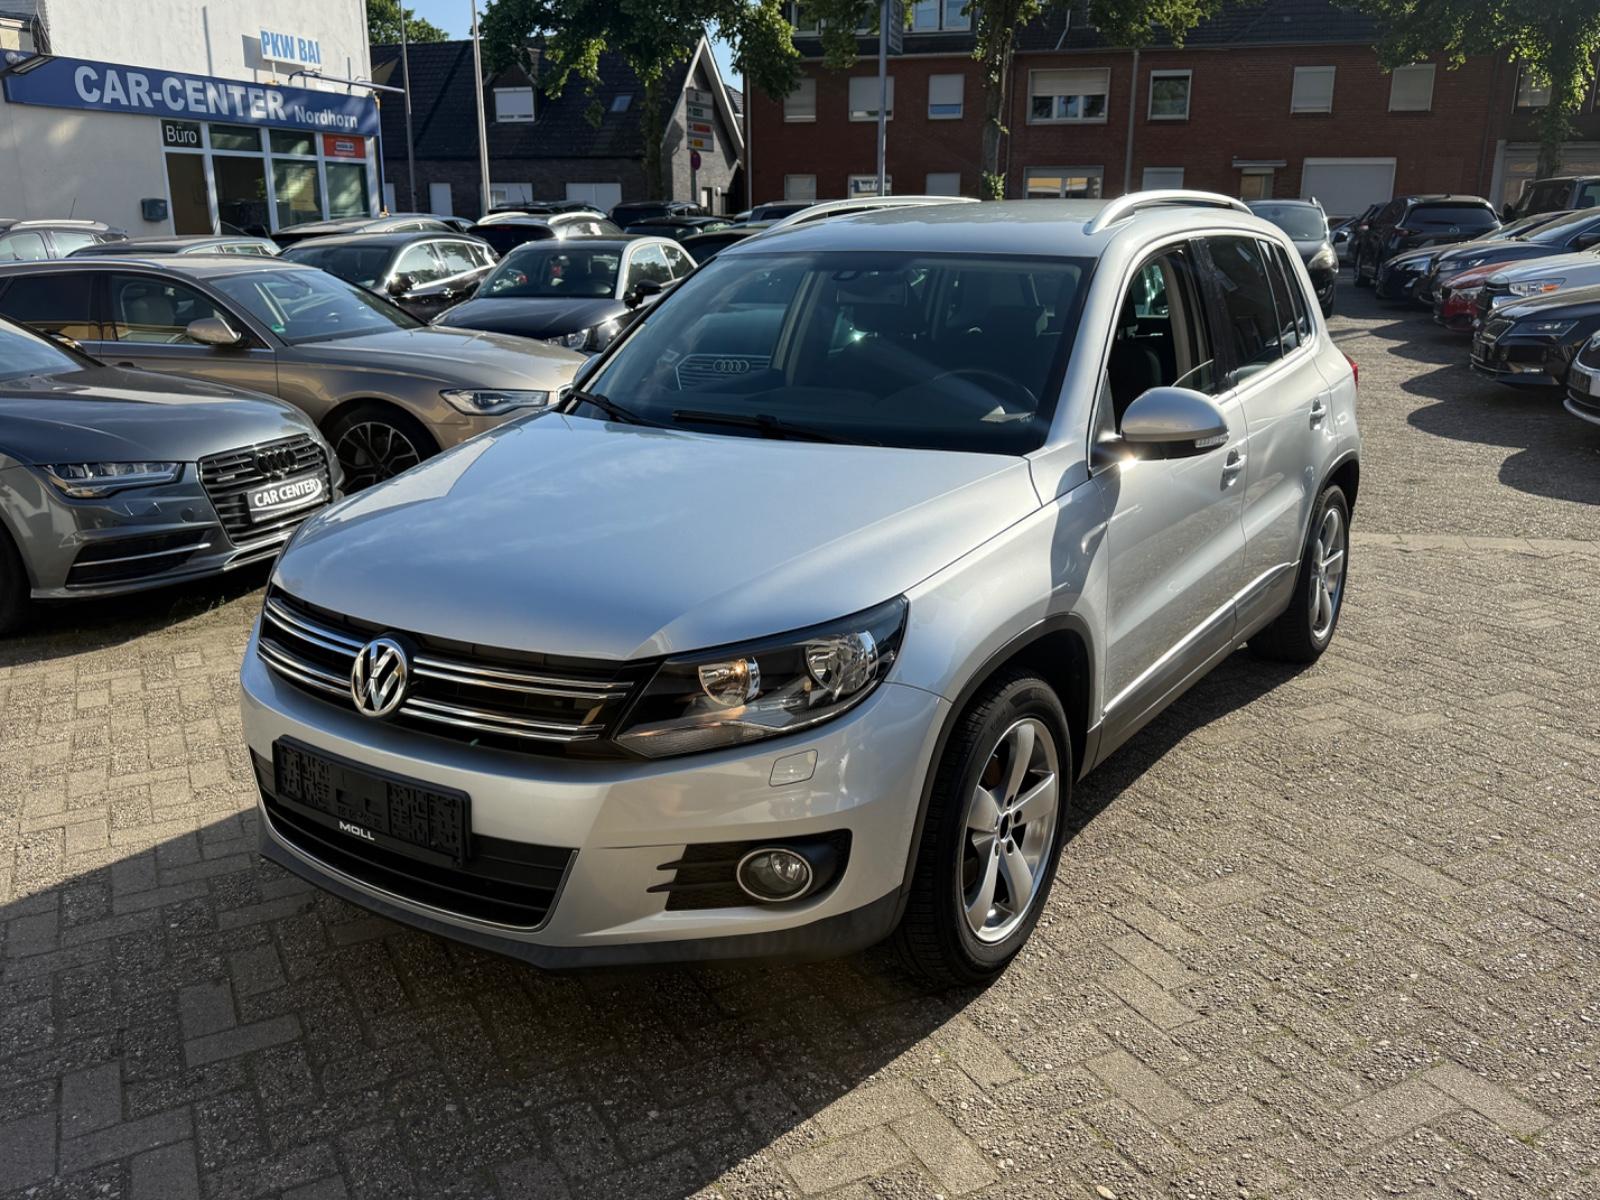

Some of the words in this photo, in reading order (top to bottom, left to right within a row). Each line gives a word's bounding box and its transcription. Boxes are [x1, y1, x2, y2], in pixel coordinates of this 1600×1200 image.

[260, 30, 295, 60] PKW
[74, 65, 287, 121] CAR-CENTER
[294, 105, 358, 129] Nordhorn
[165, 124, 198, 144] Büro
[254, 490, 279, 507] CAR
[279, 478, 317, 500] CENTER
[339, 820, 375, 841] MOLL
